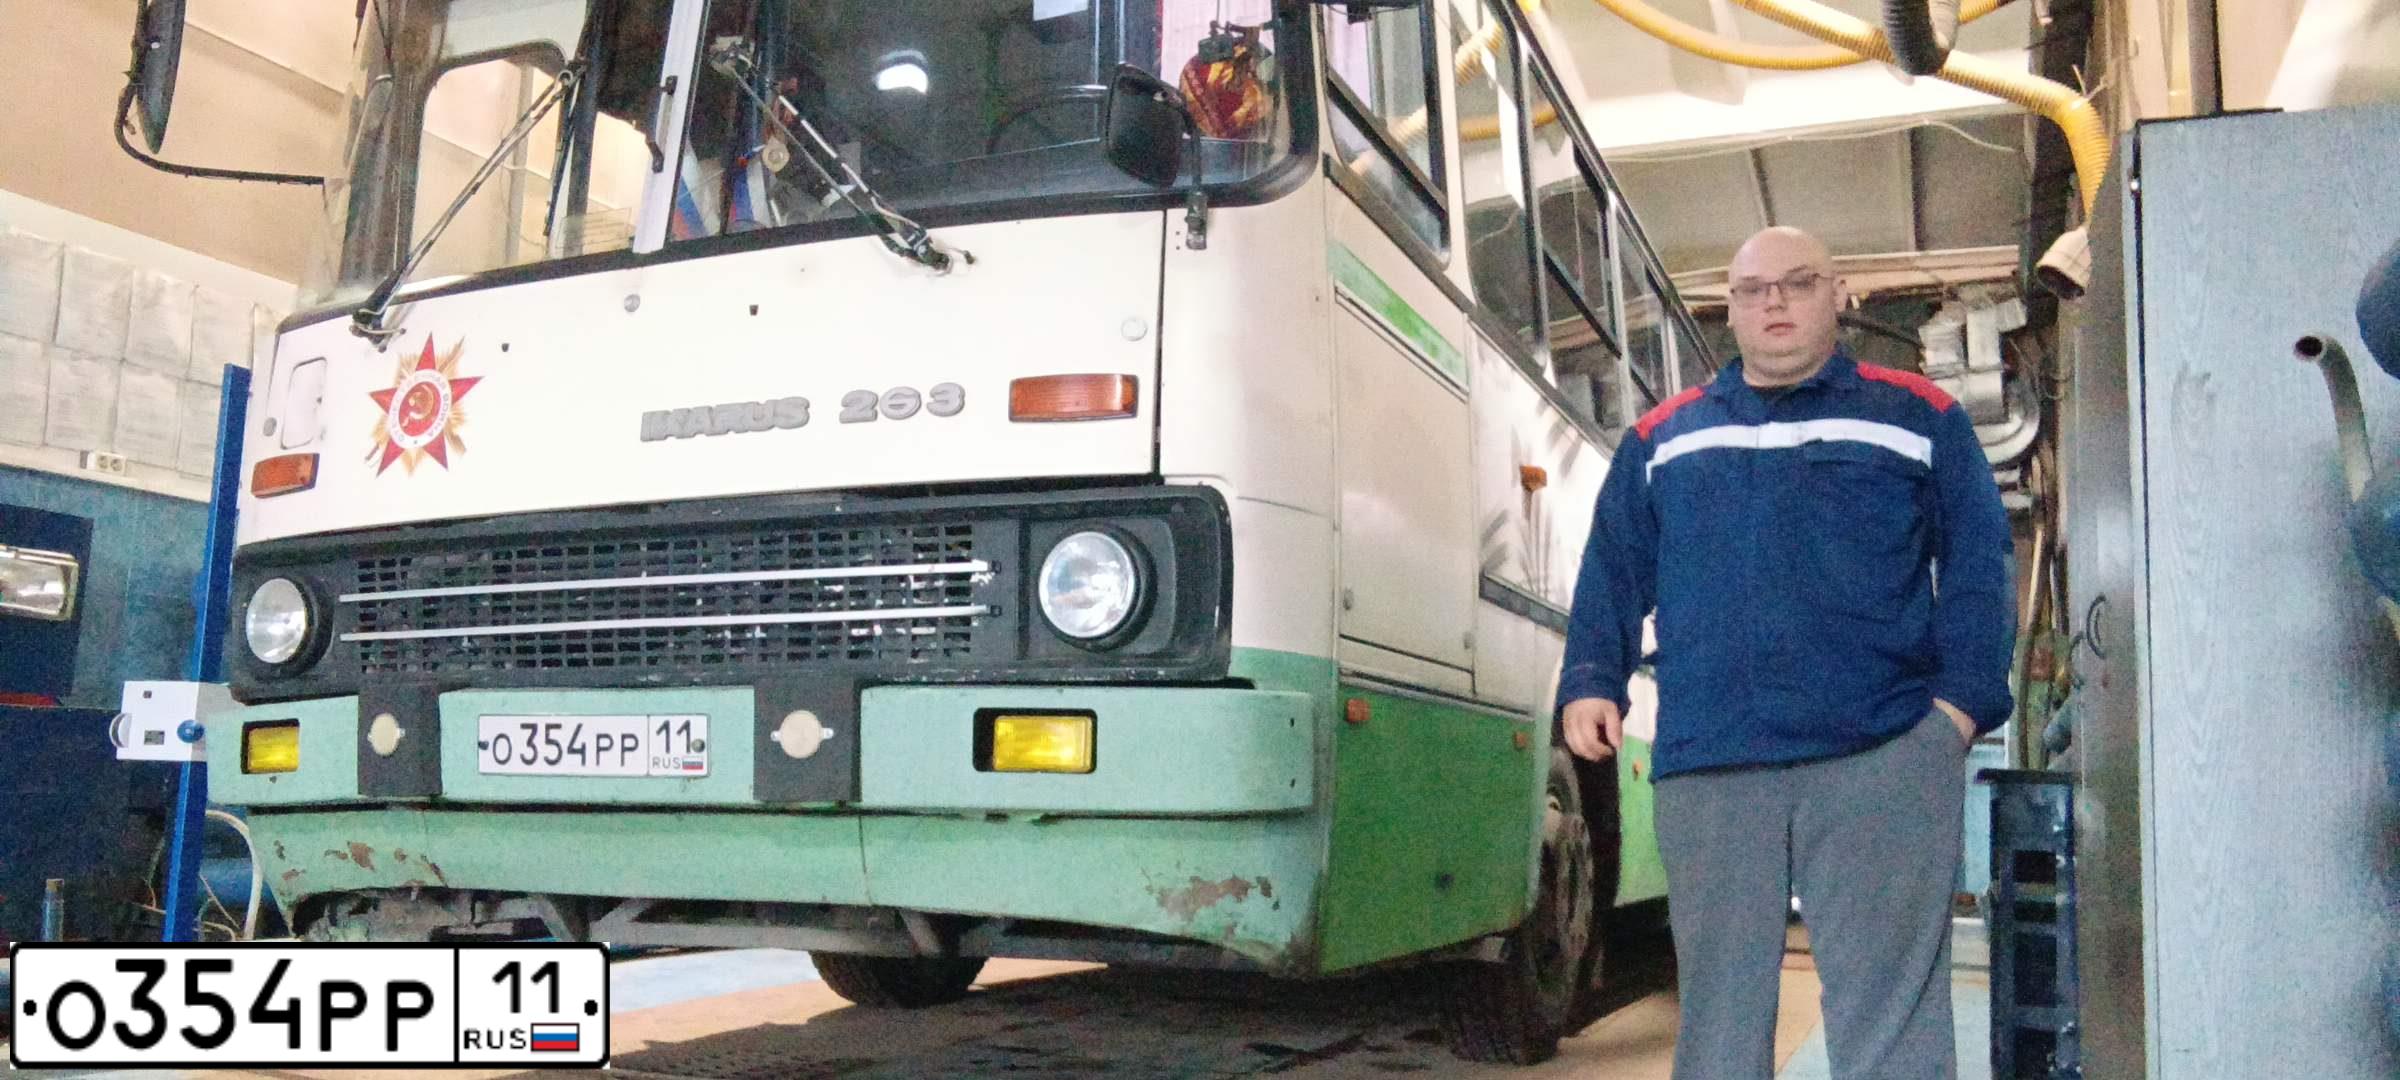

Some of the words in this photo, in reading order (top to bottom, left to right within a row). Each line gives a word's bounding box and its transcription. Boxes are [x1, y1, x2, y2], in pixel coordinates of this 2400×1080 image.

[640, 396, 810, 441] IKARUS
[838, 382, 966, 424] 263
[655, 719, 692, 754] 11
[652, 759, 681, 769] RUS
